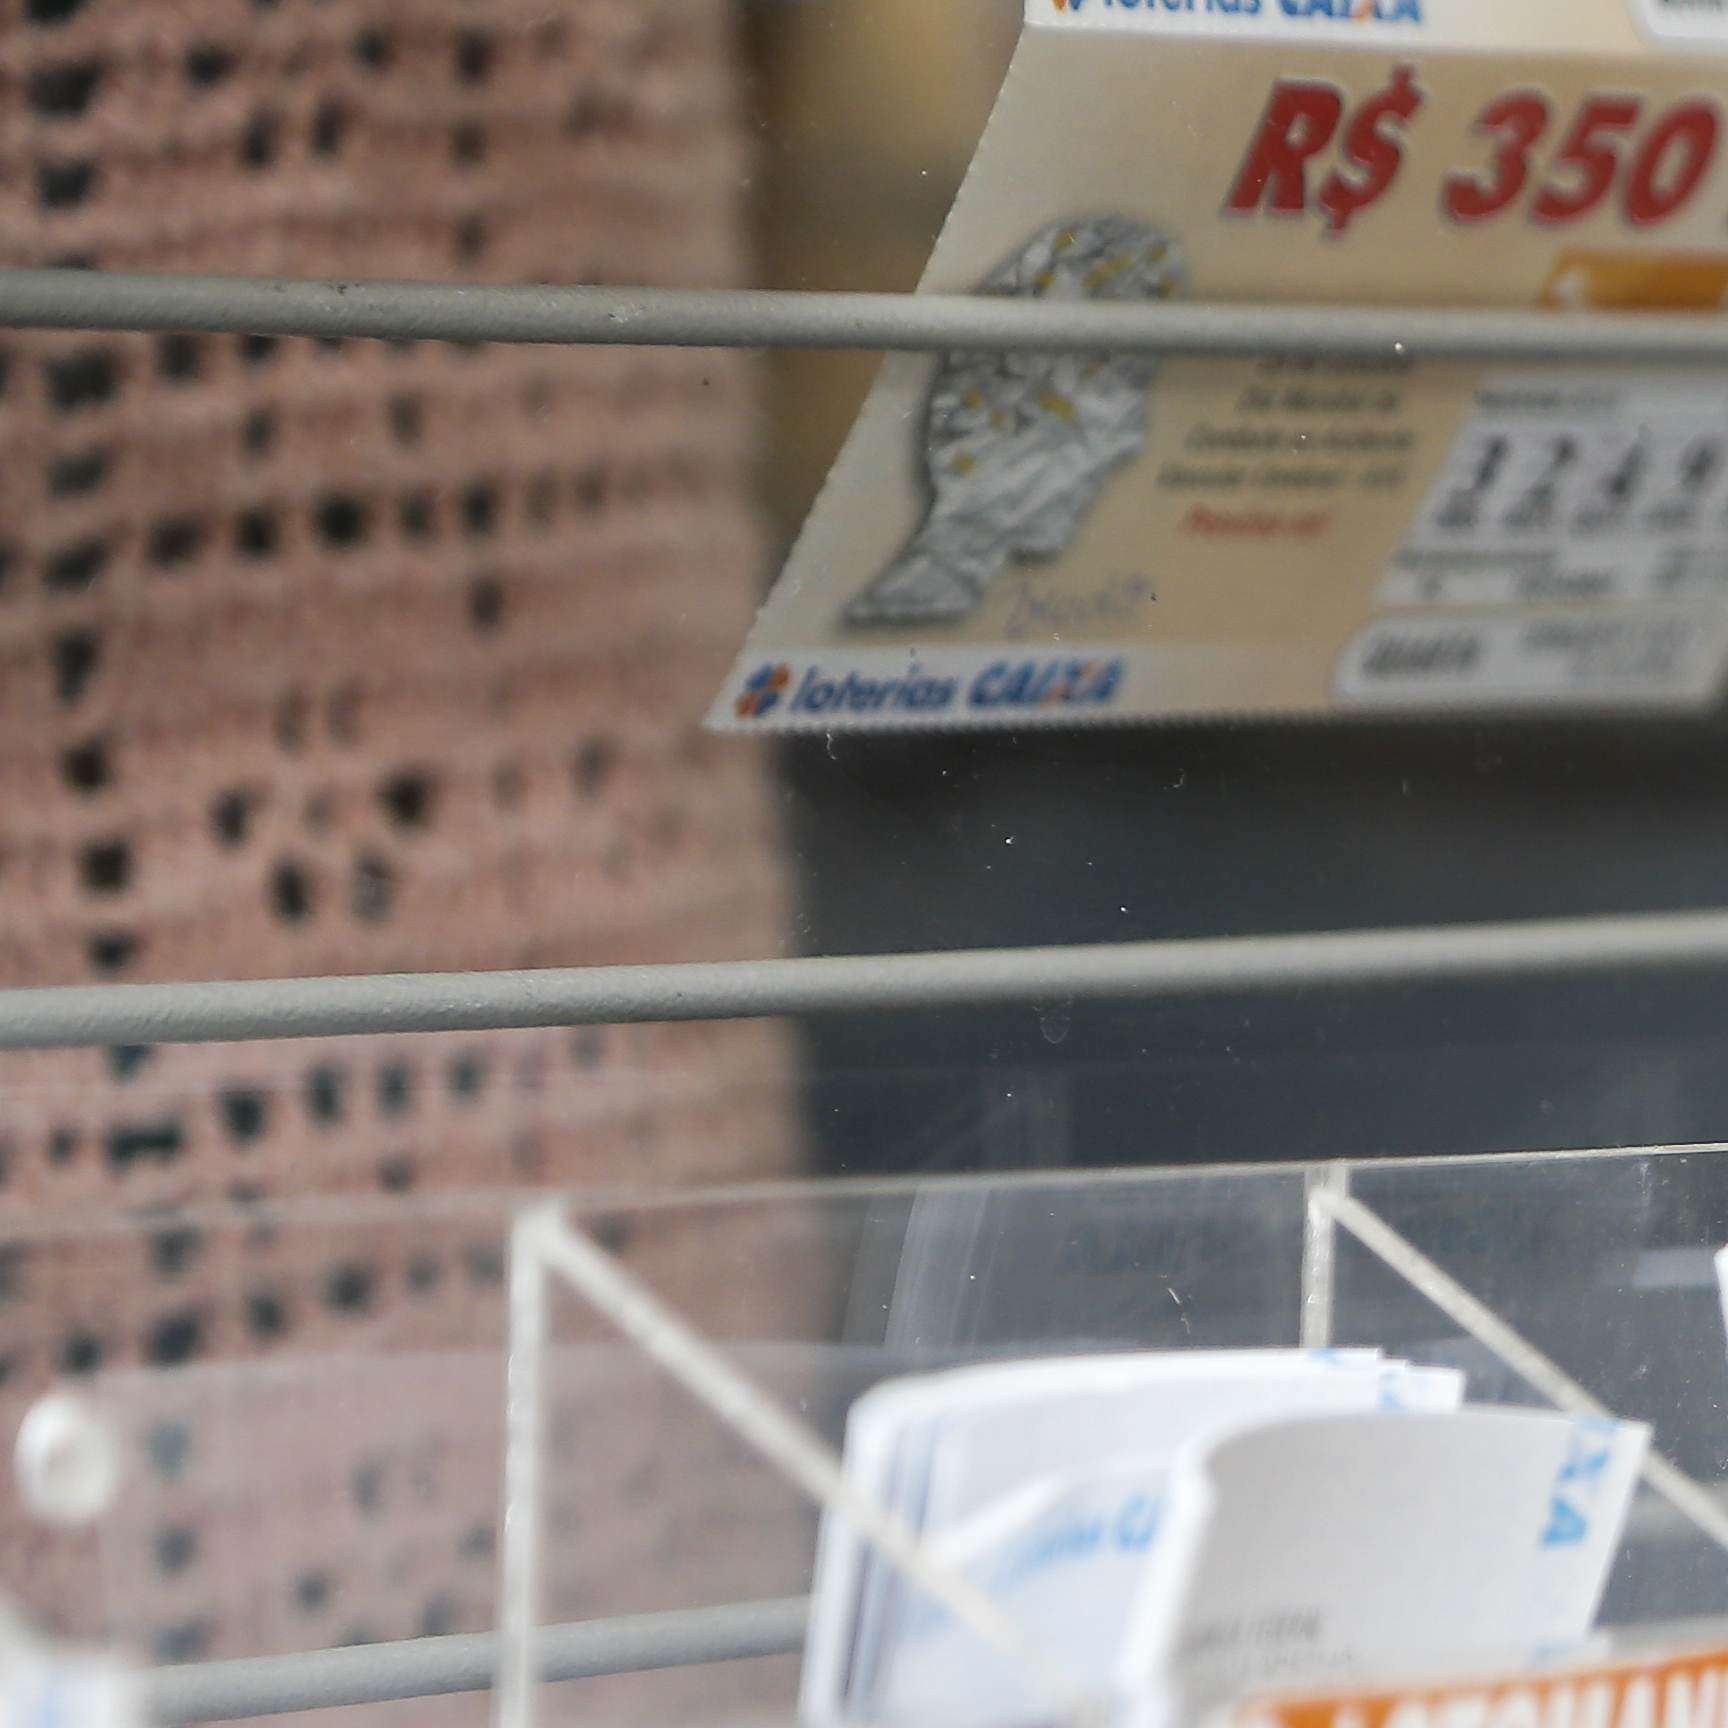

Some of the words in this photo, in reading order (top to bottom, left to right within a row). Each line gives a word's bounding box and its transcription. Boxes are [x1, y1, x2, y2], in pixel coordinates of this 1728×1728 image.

[1224, 66, 1426, 236] R$
[1440, 90, 1723, 231] 350
[788, 664, 961, 714] loterias
[967, 654, 1128, 709] CAIXA
